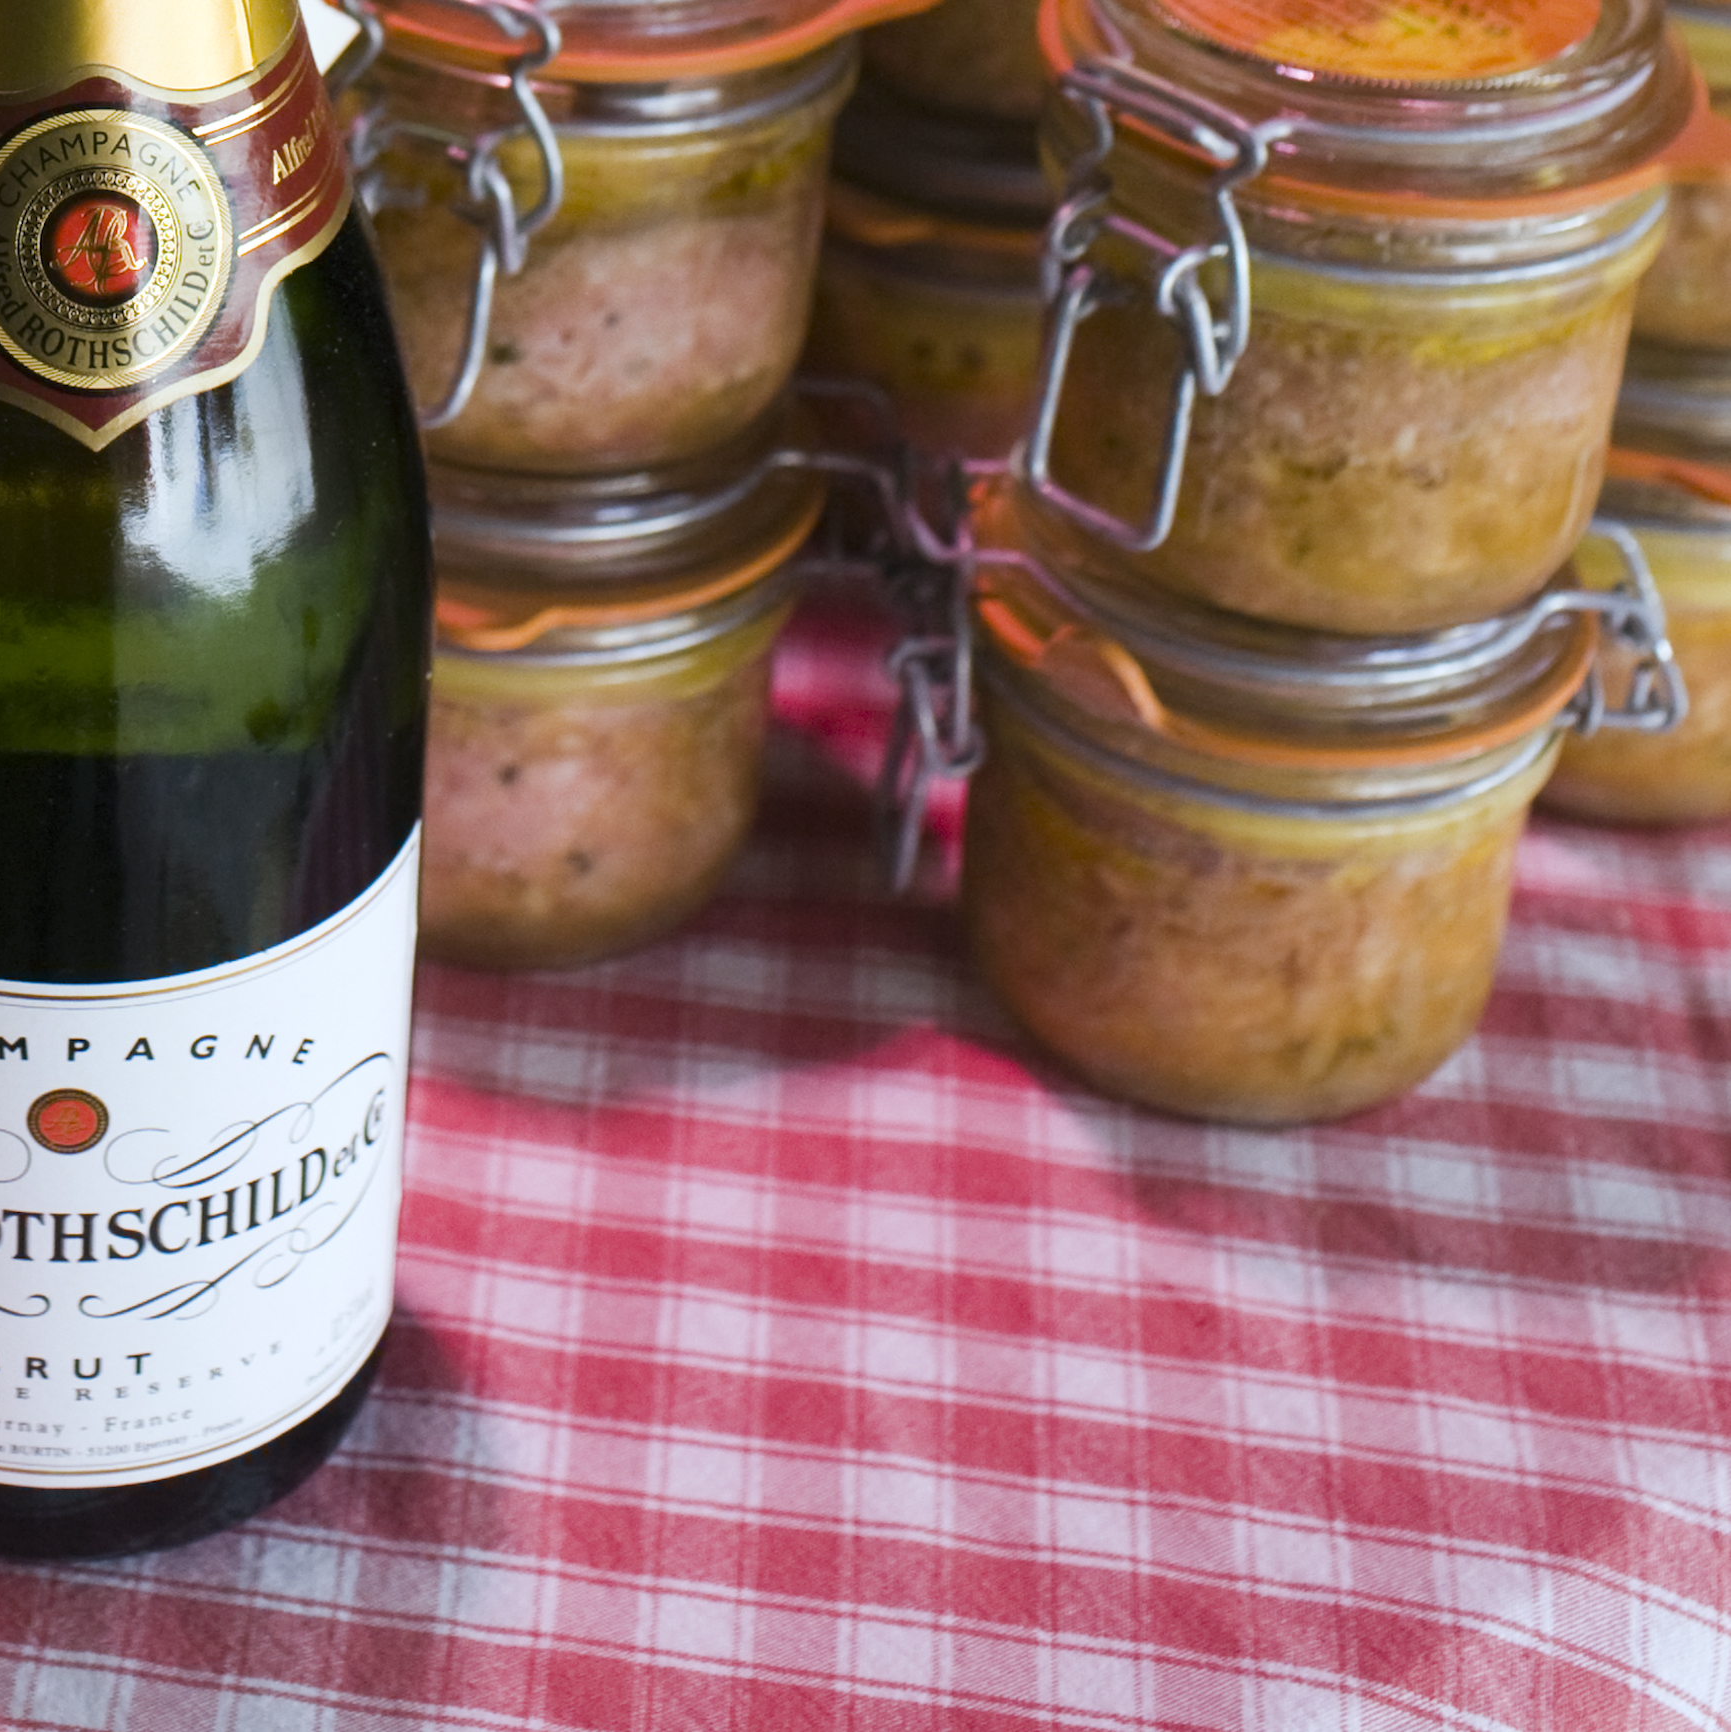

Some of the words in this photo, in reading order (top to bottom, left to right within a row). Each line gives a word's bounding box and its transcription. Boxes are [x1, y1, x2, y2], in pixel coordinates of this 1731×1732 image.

[17, 270, 211, 370] ROTHSCHILD
[200, 242, 214, 268] et
[333, 1133, 358, 1177] et
[75, 1339, 284, 1403] RESERVE
[104, 1406, 194, 1433] France
